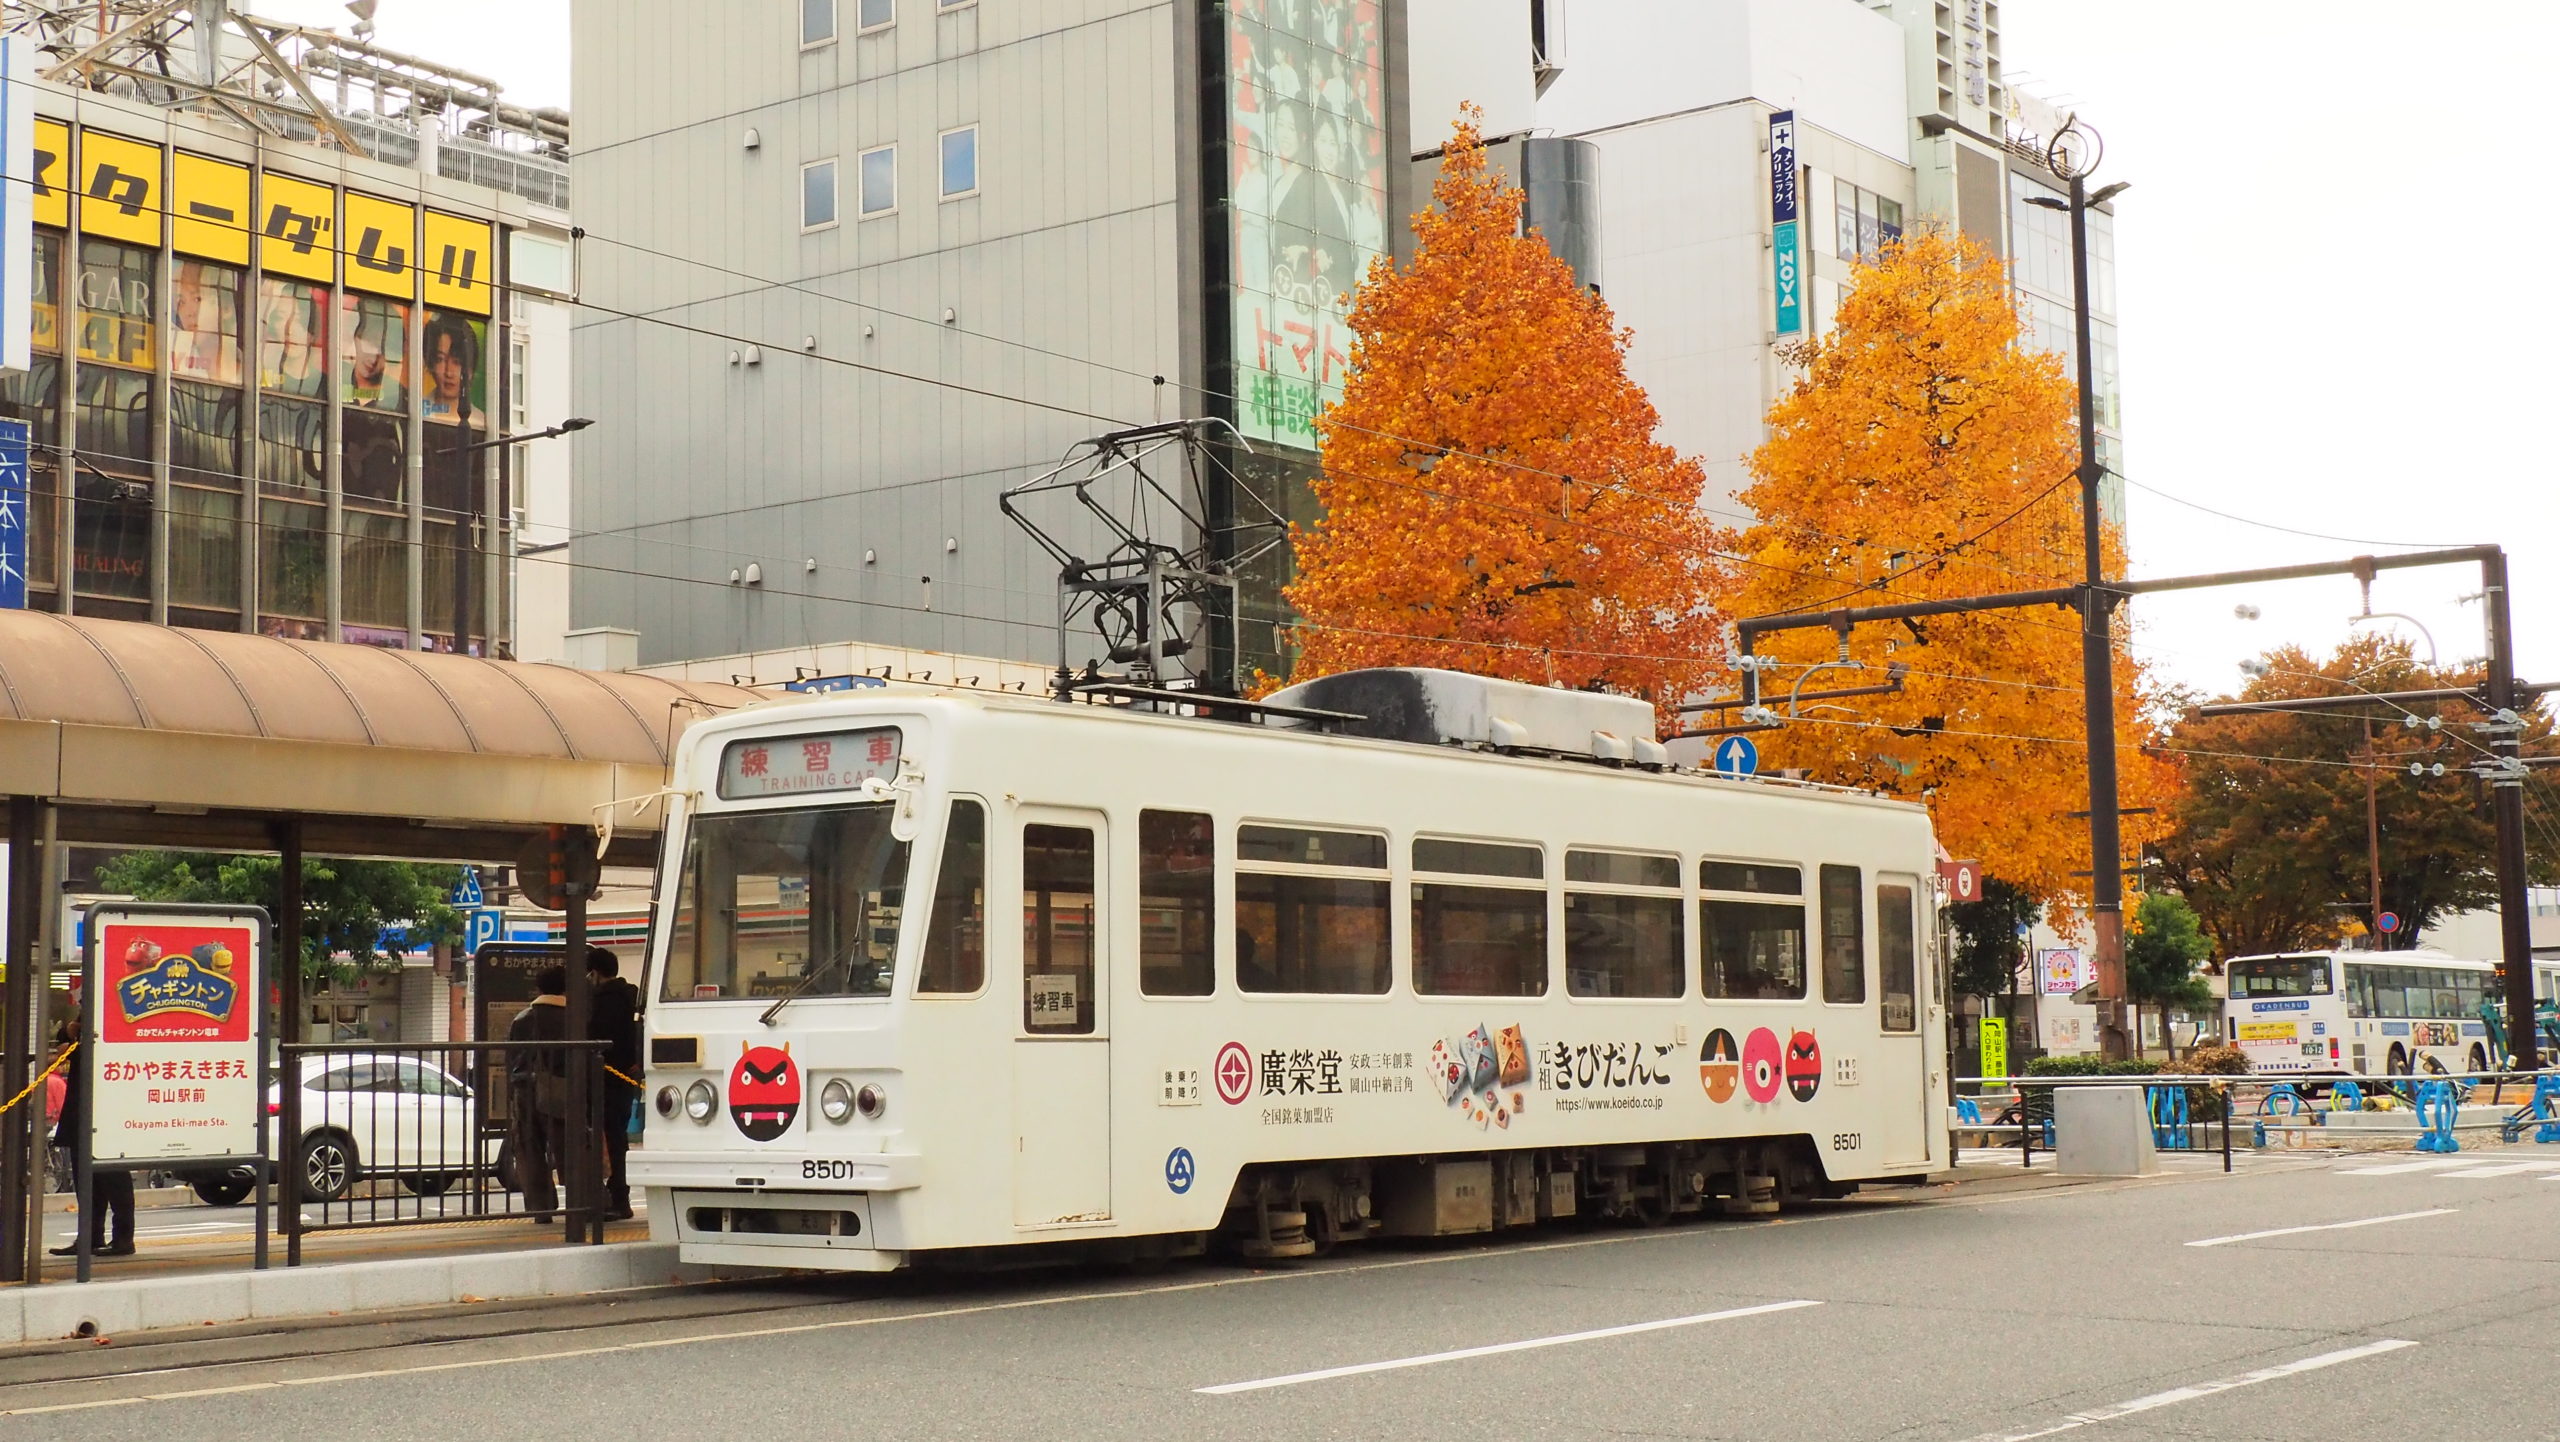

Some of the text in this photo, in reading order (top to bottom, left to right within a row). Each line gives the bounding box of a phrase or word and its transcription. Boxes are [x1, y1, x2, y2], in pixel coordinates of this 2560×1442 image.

[1773, 153, 1784, 204] クリニック
[1784, 150, 1795, 211] メンズライフ
[1780, 250, 1796, 308] NOVA
[81, 315, 147, 364] 4F
[1255, 307, 1347, 383] トマト
[741, 736, 897, 778] 練習車
[761, 772, 837, 792] TRAINING
[477, 915, 495, 946] P
[130, 978, 225, 1005] チャギントン
[2047, 981, 2077, 989] ジャンカラ
[146, 998, 208, 1010] CHUGGINGTON
[1033, 991, 1075, 1012] 練習車
[2254, 1001, 2308, 1011] OKADENBUS
[135, 1028, 220, 1037] おかでんチャギントン電車
[103, 1060, 249, 1082] おかやまえきまえ
[1349, 1052, 1414, 1070] 安政三年創業
[1537, 1041, 1552, 1091] 元祖
[1554, 1041, 1675, 1091] きびだんご
[1164, 1070, 1199, 1084] 後乗り
[1259, 1049, 1343, 1097] 廣榮堂
[147, 1088, 206, 1104] 岡山駅前
[1164, 1086, 1199, 1100] 前降り
[1556, 1095, 1664, 1114] https://www.koeido.co.jp
[124, 1117, 229, 1131] Okayama Eki-mae Sta.
[1261, 1106, 1334, 1126] 全国銘菓加盟店
[1833, 1132, 1862, 1151] 8501
[801, 1159, 854, 1180] 8501
